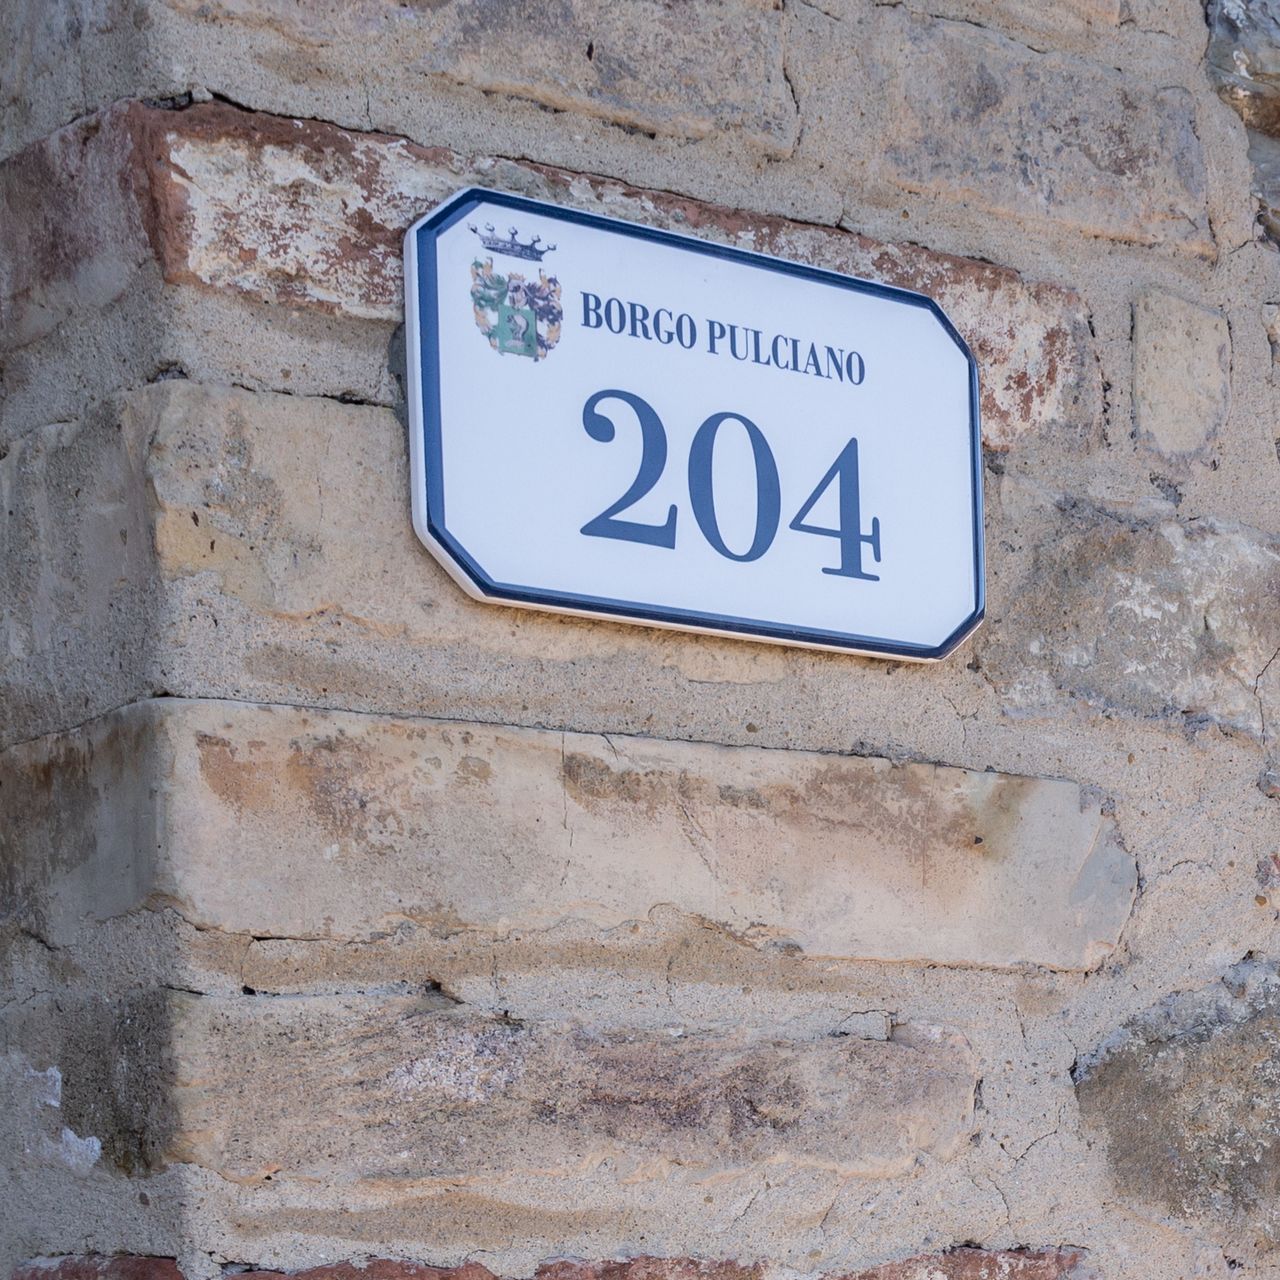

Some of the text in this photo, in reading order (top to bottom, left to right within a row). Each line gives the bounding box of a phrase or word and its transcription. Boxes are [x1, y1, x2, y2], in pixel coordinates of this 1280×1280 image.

[580, 291, 866, 386] BORGO PULCIANO
[580, 389, 881, 581] 204
